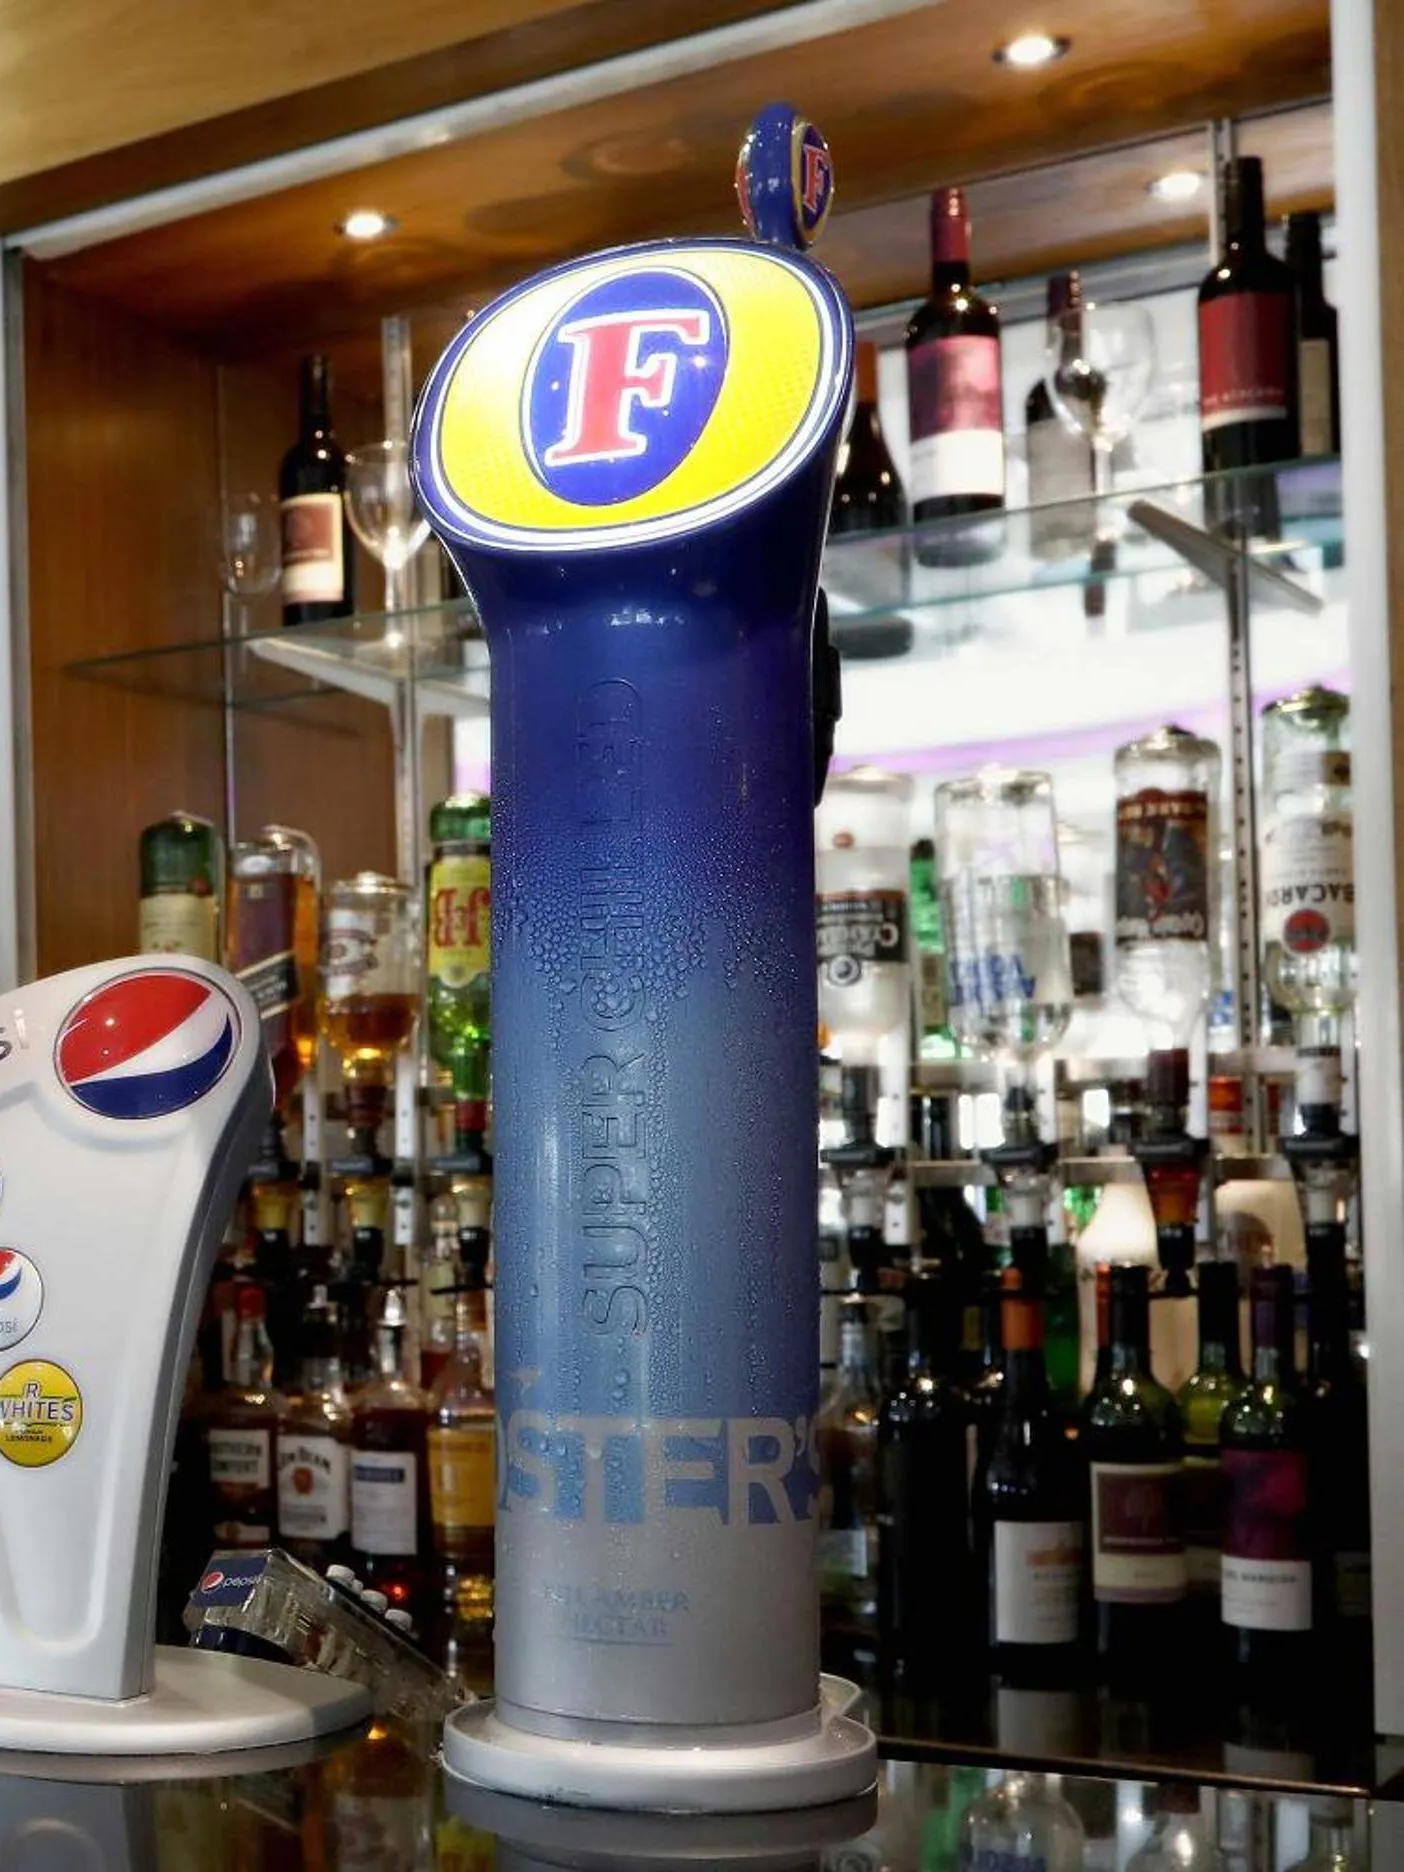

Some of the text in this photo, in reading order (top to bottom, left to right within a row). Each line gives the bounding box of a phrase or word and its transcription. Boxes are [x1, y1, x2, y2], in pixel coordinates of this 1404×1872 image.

[544, 309, 709, 466] F
[581, 1054, 647, 1337] SUPER
[25, 1382, 39, 1399] R
